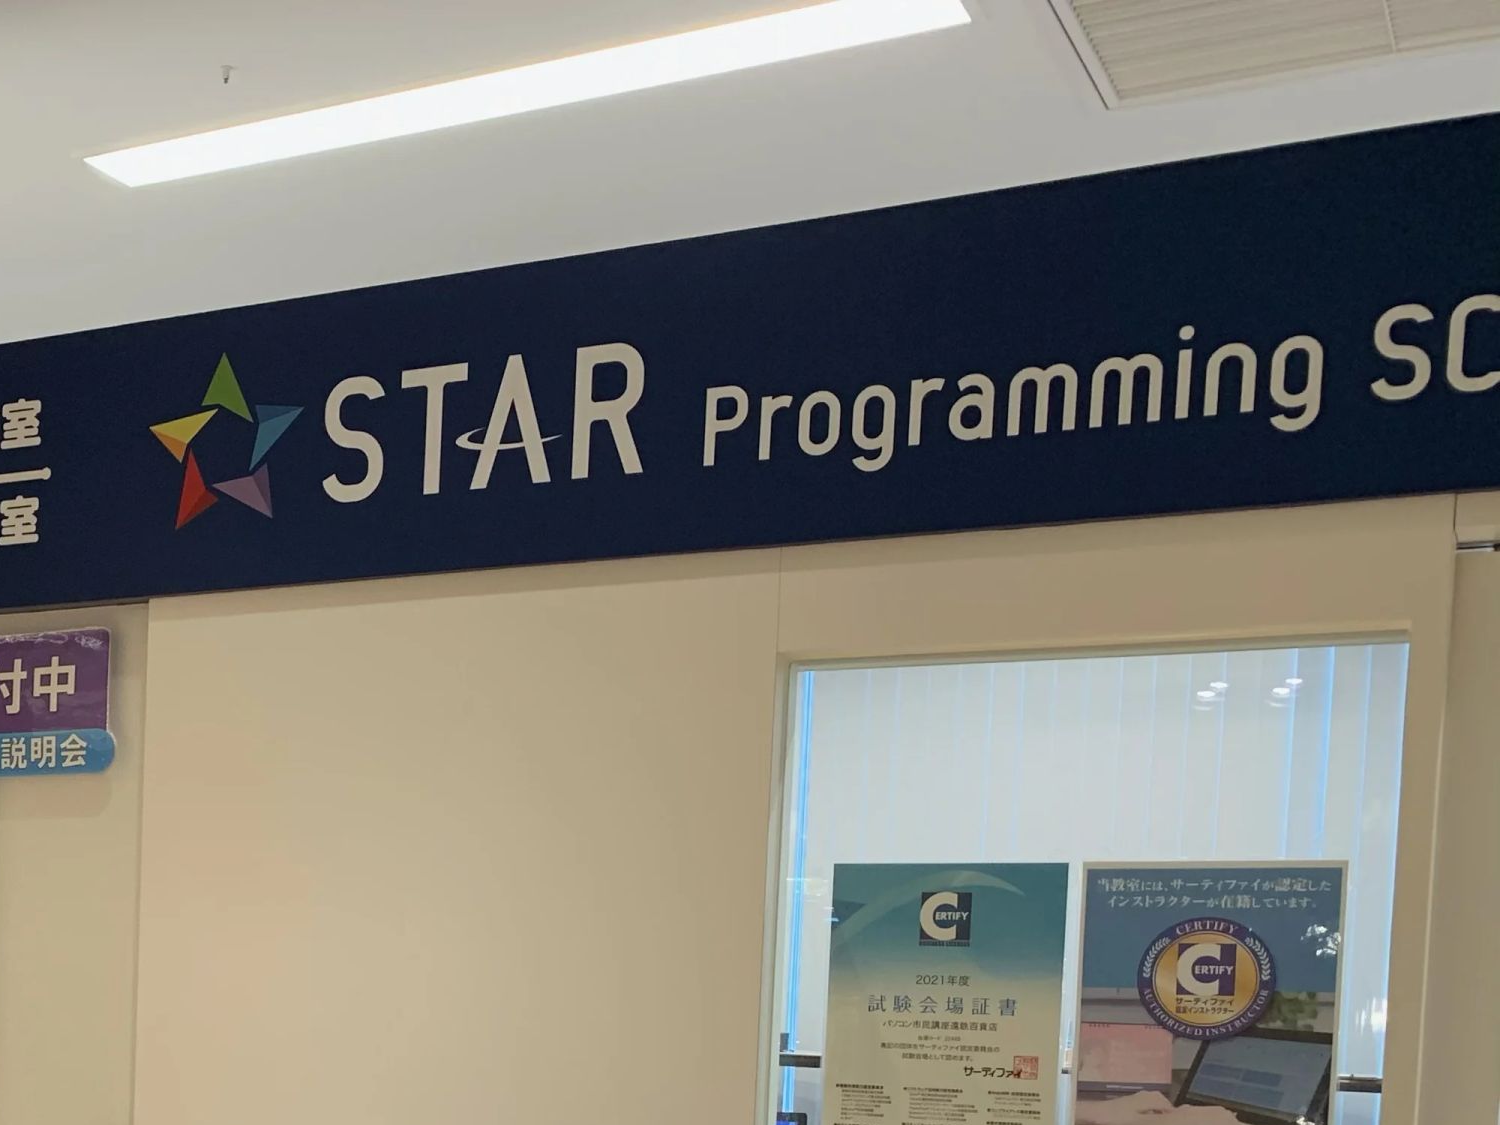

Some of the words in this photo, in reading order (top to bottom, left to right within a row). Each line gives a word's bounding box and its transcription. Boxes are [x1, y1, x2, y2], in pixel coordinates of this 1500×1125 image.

[322, 341, 646, 504] STAR
[701, 326, 1324, 474] Programming
[1097, 876, 1332, 893] 当教室には、サーティファイが認定した
[1107, 894, 1318, 910] インストラクターが在籍しています。
[1175, 919, 1238, 937] CERTIFY
[915, 974, 971, 988] 2021年度
[867, 994, 1019, 1018] 試験会場証書
[963, 1065, 1025, 1079] サーティファイ
